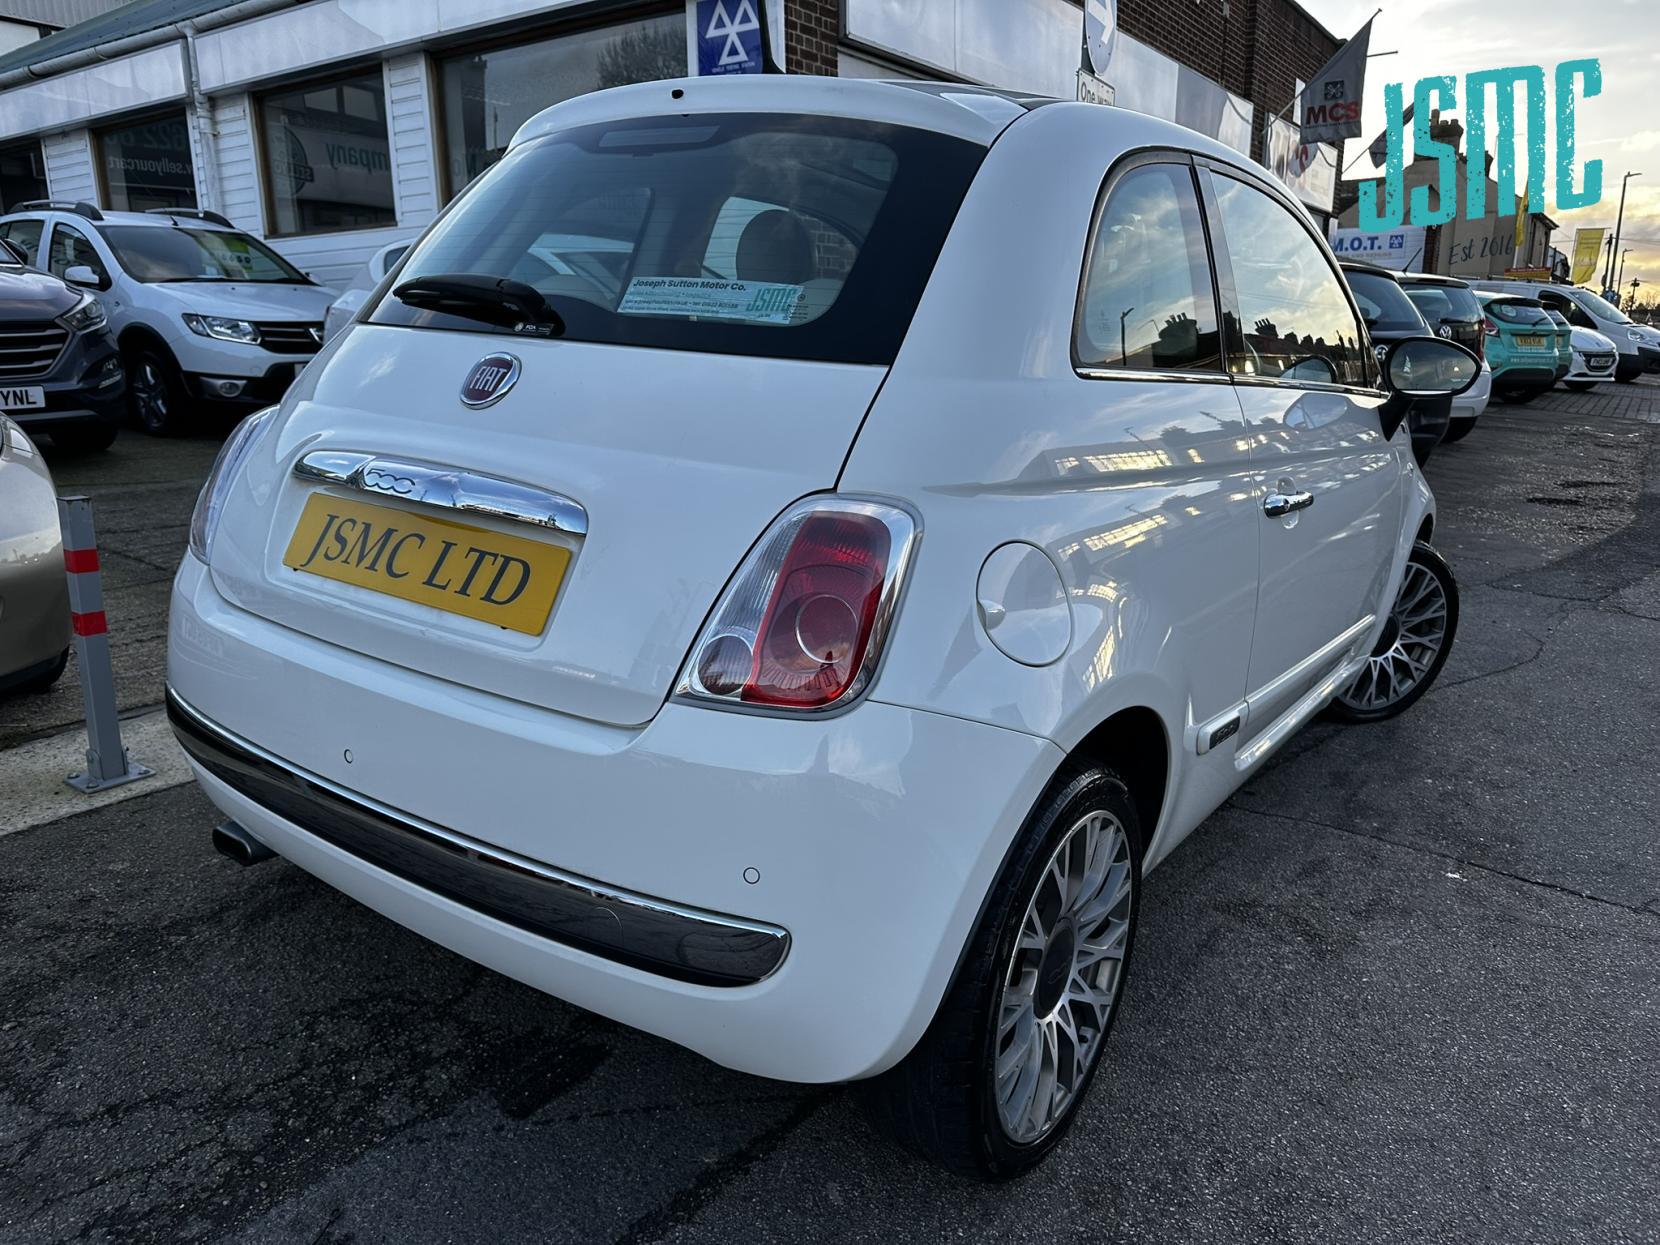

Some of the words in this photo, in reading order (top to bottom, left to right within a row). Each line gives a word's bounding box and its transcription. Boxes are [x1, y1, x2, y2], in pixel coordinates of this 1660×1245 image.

[1081, 82, 1095, 103] One
[1306, 101, 1359, 125] MCS
[1334, 236, 1382, 252] M.O.T.
[1448, 238, 1475, 265] Est
[1480, 234, 1512, 258] 2016
[633, 279, 666, 289] Joseph
[668, 279, 699, 289] Sutton
[700, 280, 731, 290] Motor
[731, 282, 747, 291] Co.
[746, 287, 798, 312] JSMC
[469, 366, 508, 391] FIAT
[0, 389, 37, 407] YNL
[300, 513, 426, 579] JSMC
[422, 540, 531, 606] LTD
